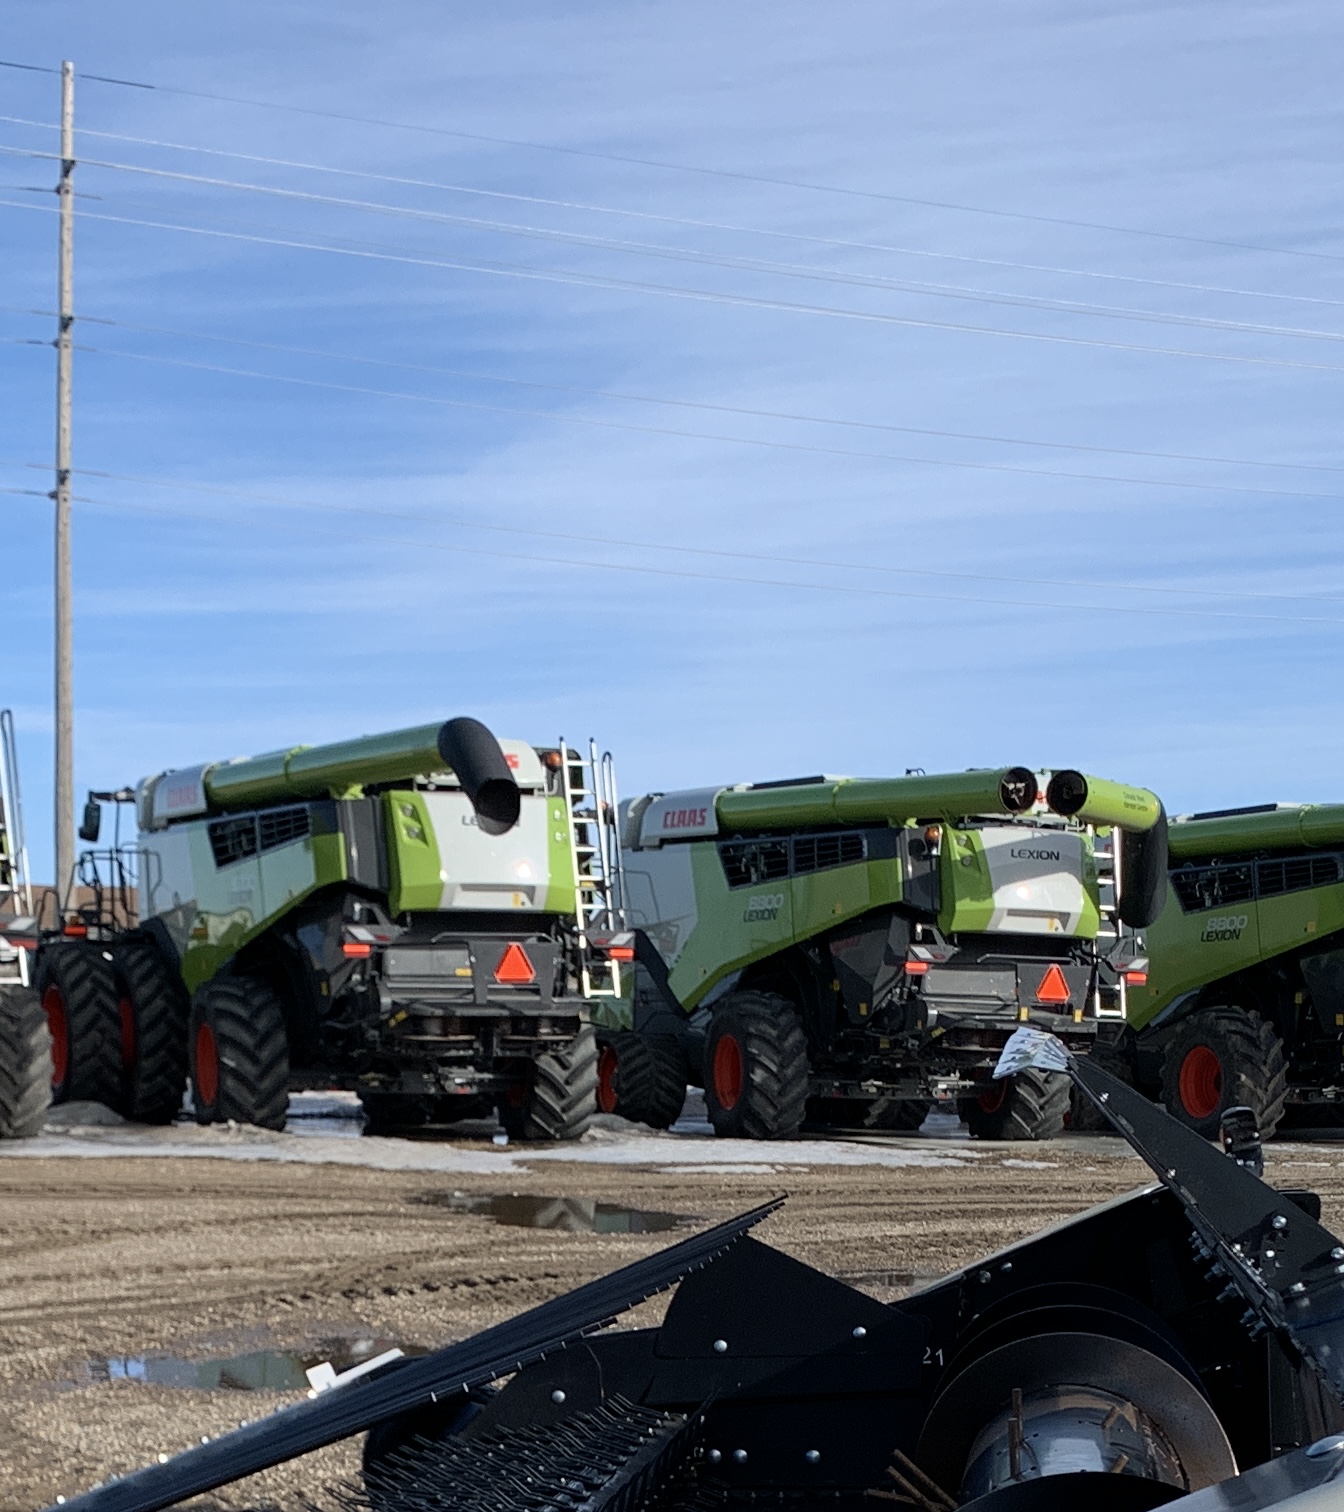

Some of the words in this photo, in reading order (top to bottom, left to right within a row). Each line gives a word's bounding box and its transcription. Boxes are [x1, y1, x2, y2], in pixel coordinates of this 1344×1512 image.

[662, 808, 707, 829] CLAAS
[1010, 848, 1060, 861] LEXION
[1207, 915, 1247, 931] 8800
[1201, 928, 1241, 942] LEXION
[922, 1346, 944, 1367] 21
